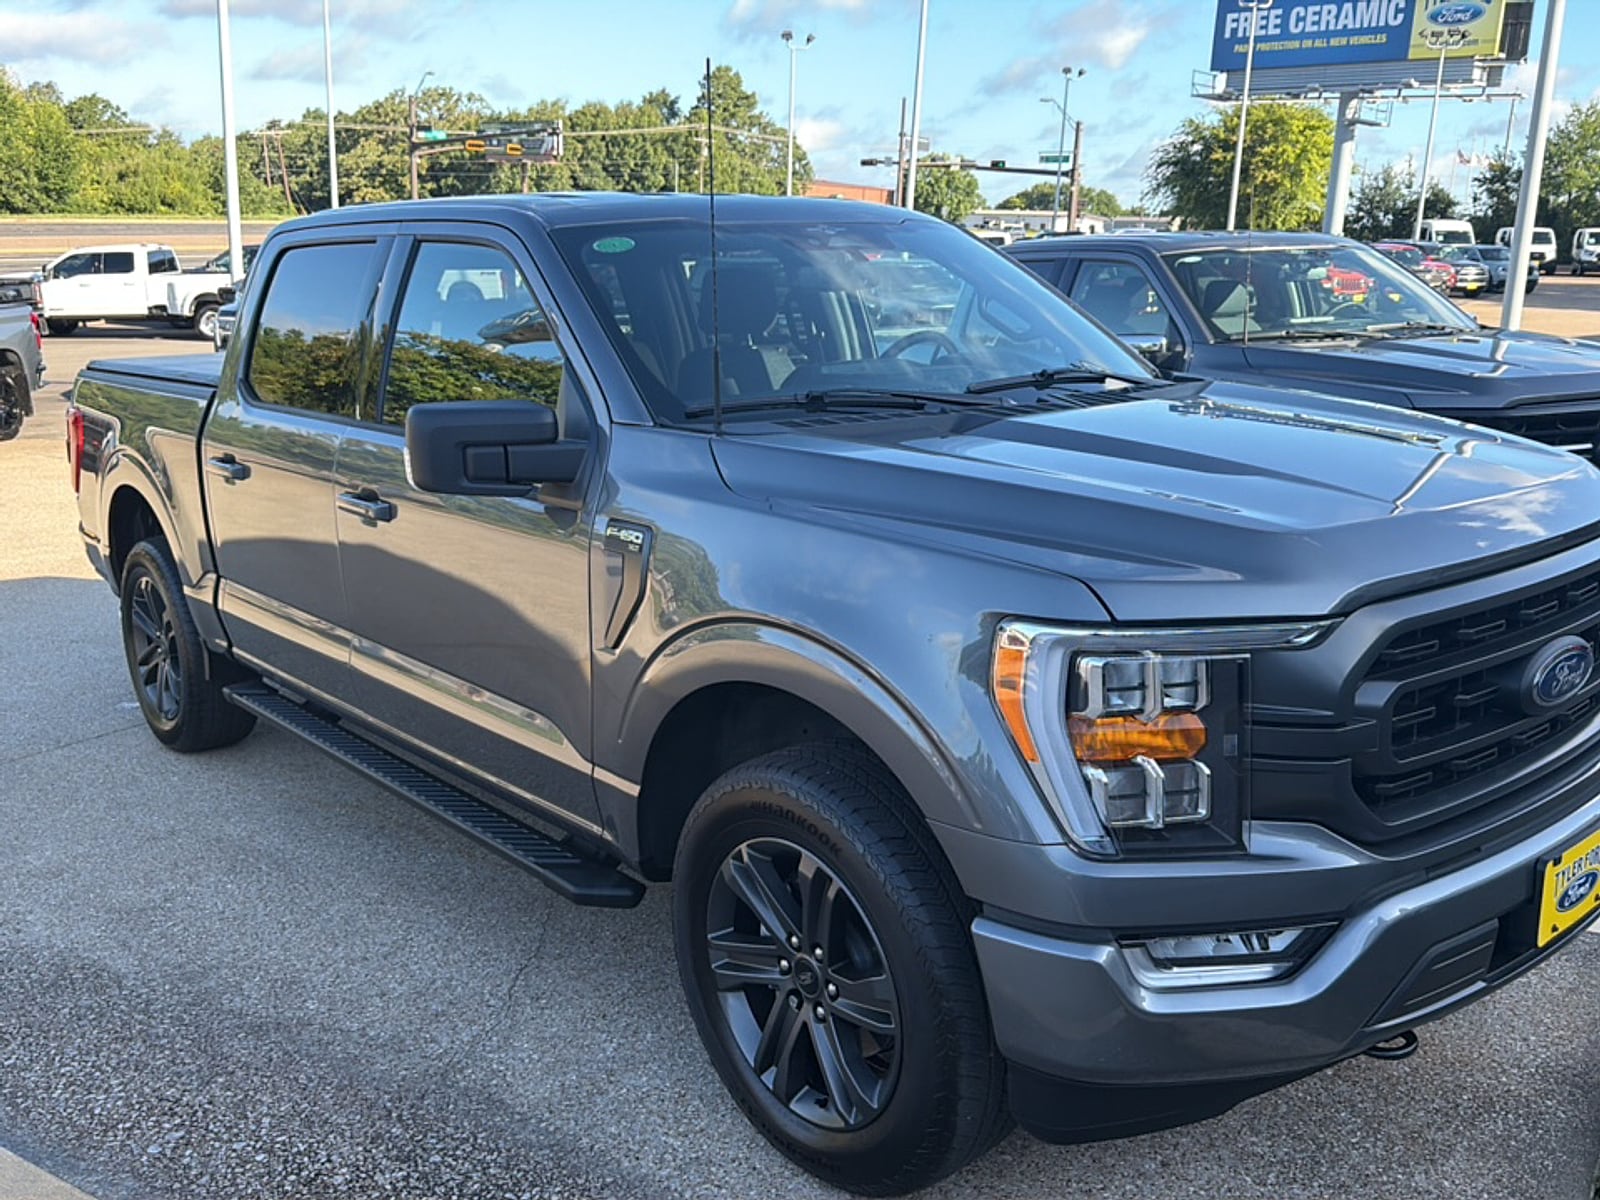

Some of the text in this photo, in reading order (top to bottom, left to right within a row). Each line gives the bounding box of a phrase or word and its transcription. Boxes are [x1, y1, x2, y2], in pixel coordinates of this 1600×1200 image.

[1224, 0, 1406, 38] FREE CERAMIC
[1437, 6, 1475, 22] Ford
[1551, 656, 1585, 696] Ford
[1563, 875, 1593, 907] Ford
